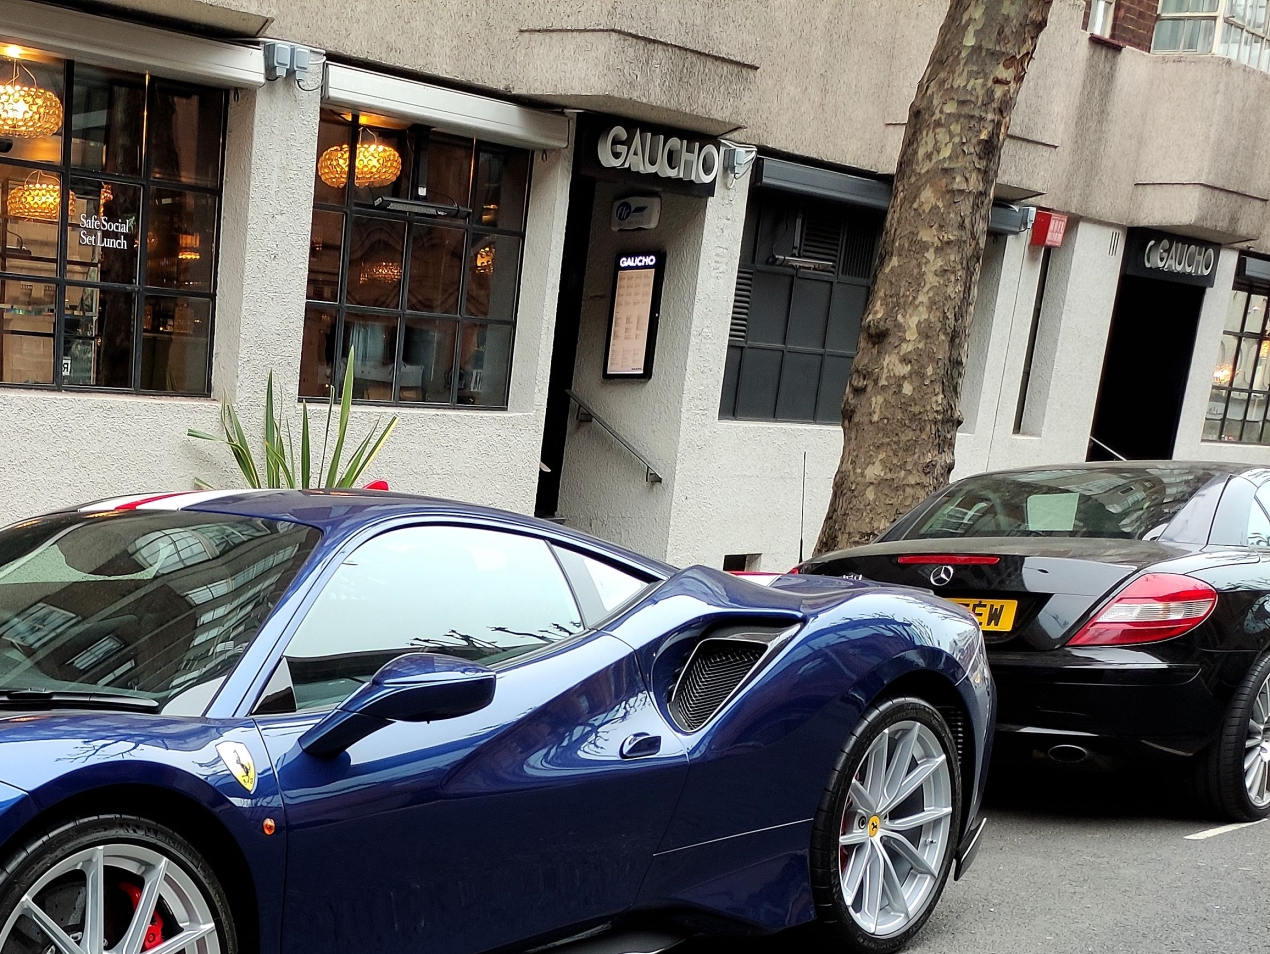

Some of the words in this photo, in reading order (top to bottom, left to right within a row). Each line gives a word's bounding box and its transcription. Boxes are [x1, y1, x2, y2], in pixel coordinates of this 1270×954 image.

[599, 126, 719, 184] GAUCHO
[80, 214, 100, 230] Safe
[101, 216, 129, 233] Social
[80, 231, 96, 246] Set
[96, 232, 127, 249] Lunch
[620, 255, 656, 267] GAUCHO
[1145, 239, 1214, 276] GAUCHO
[958, 601, 1004, 626] EW
